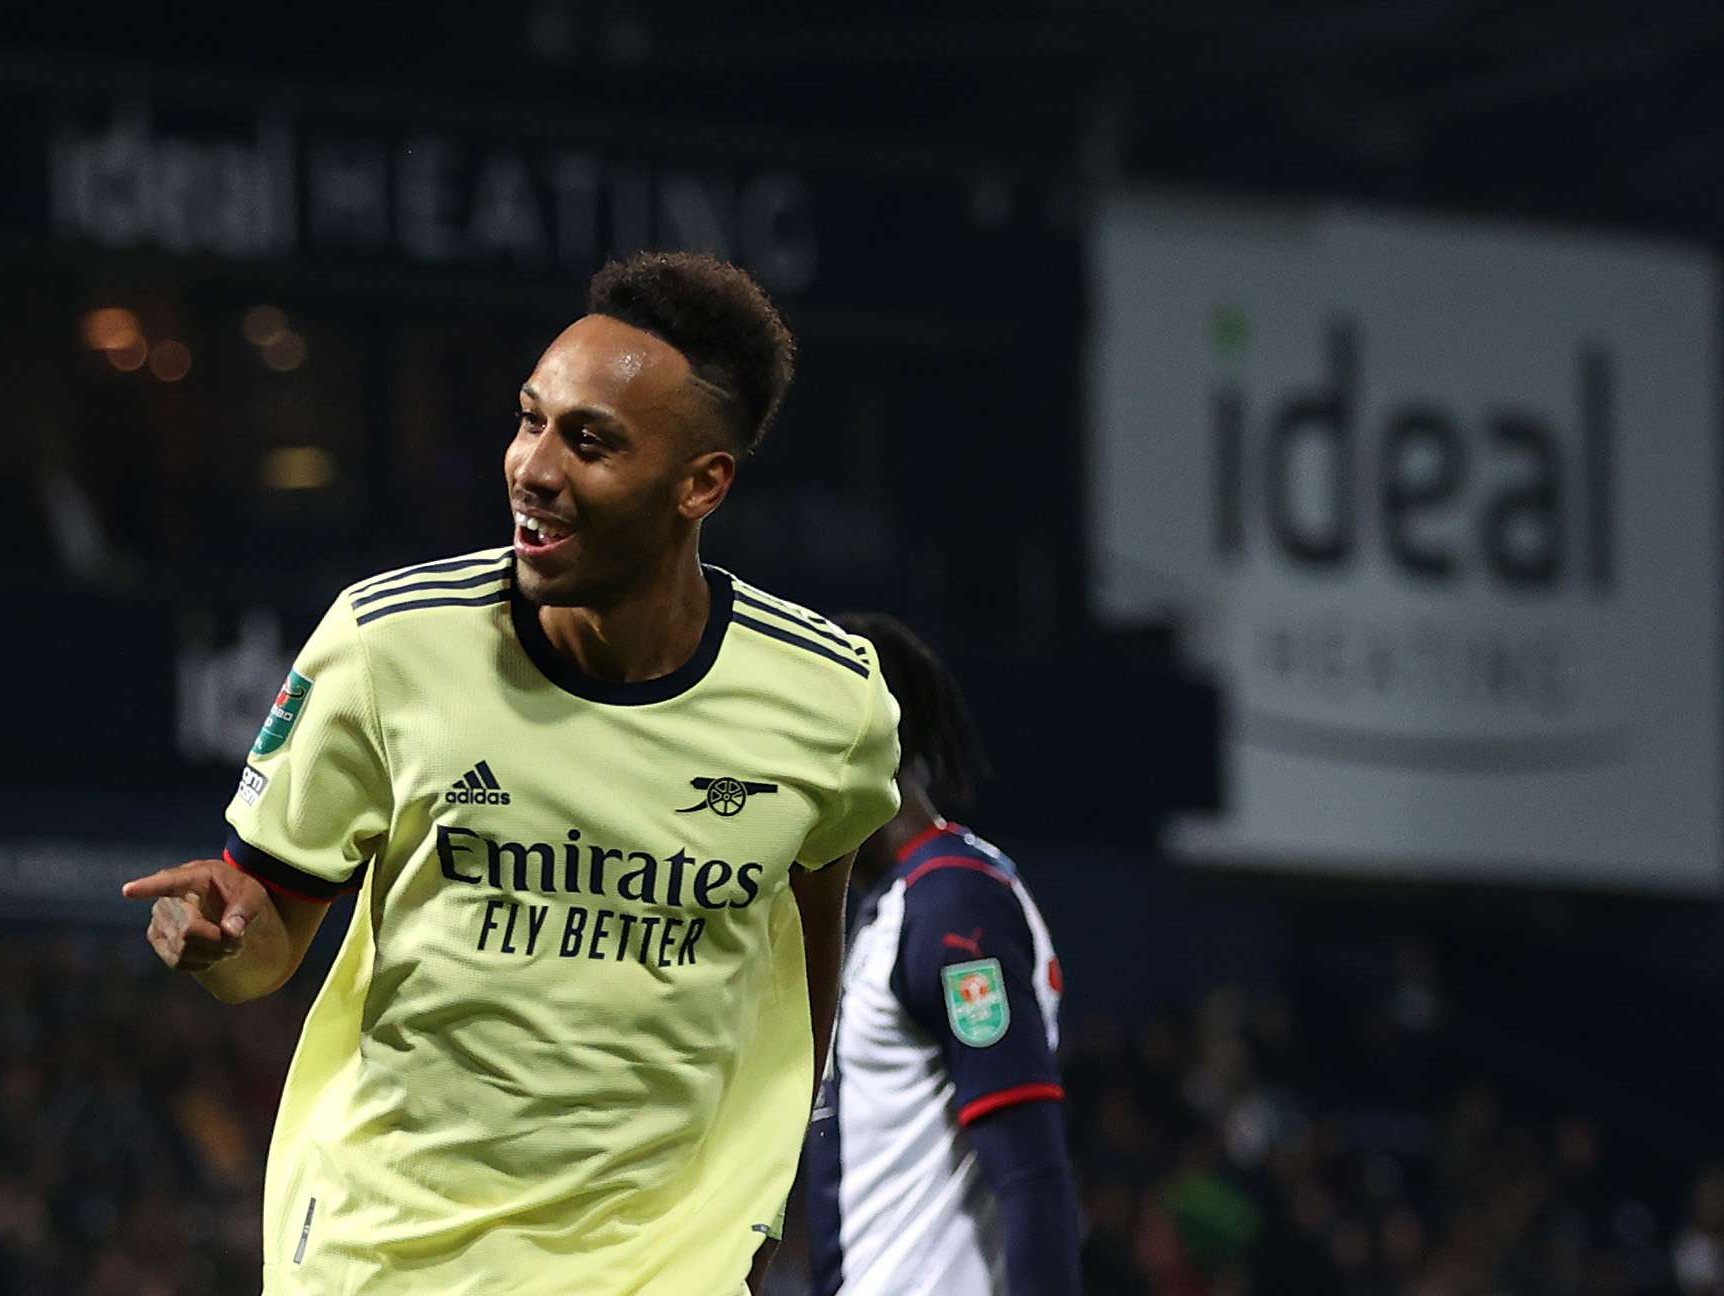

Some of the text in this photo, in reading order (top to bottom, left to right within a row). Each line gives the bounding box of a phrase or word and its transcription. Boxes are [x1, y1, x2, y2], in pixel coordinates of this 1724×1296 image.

[1206, 305, 1622, 600] ideal
[445, 788, 511, 806] adidas
[436, 824, 764, 910] Emirates
[477, 899, 707, 968] FLY BETTER
